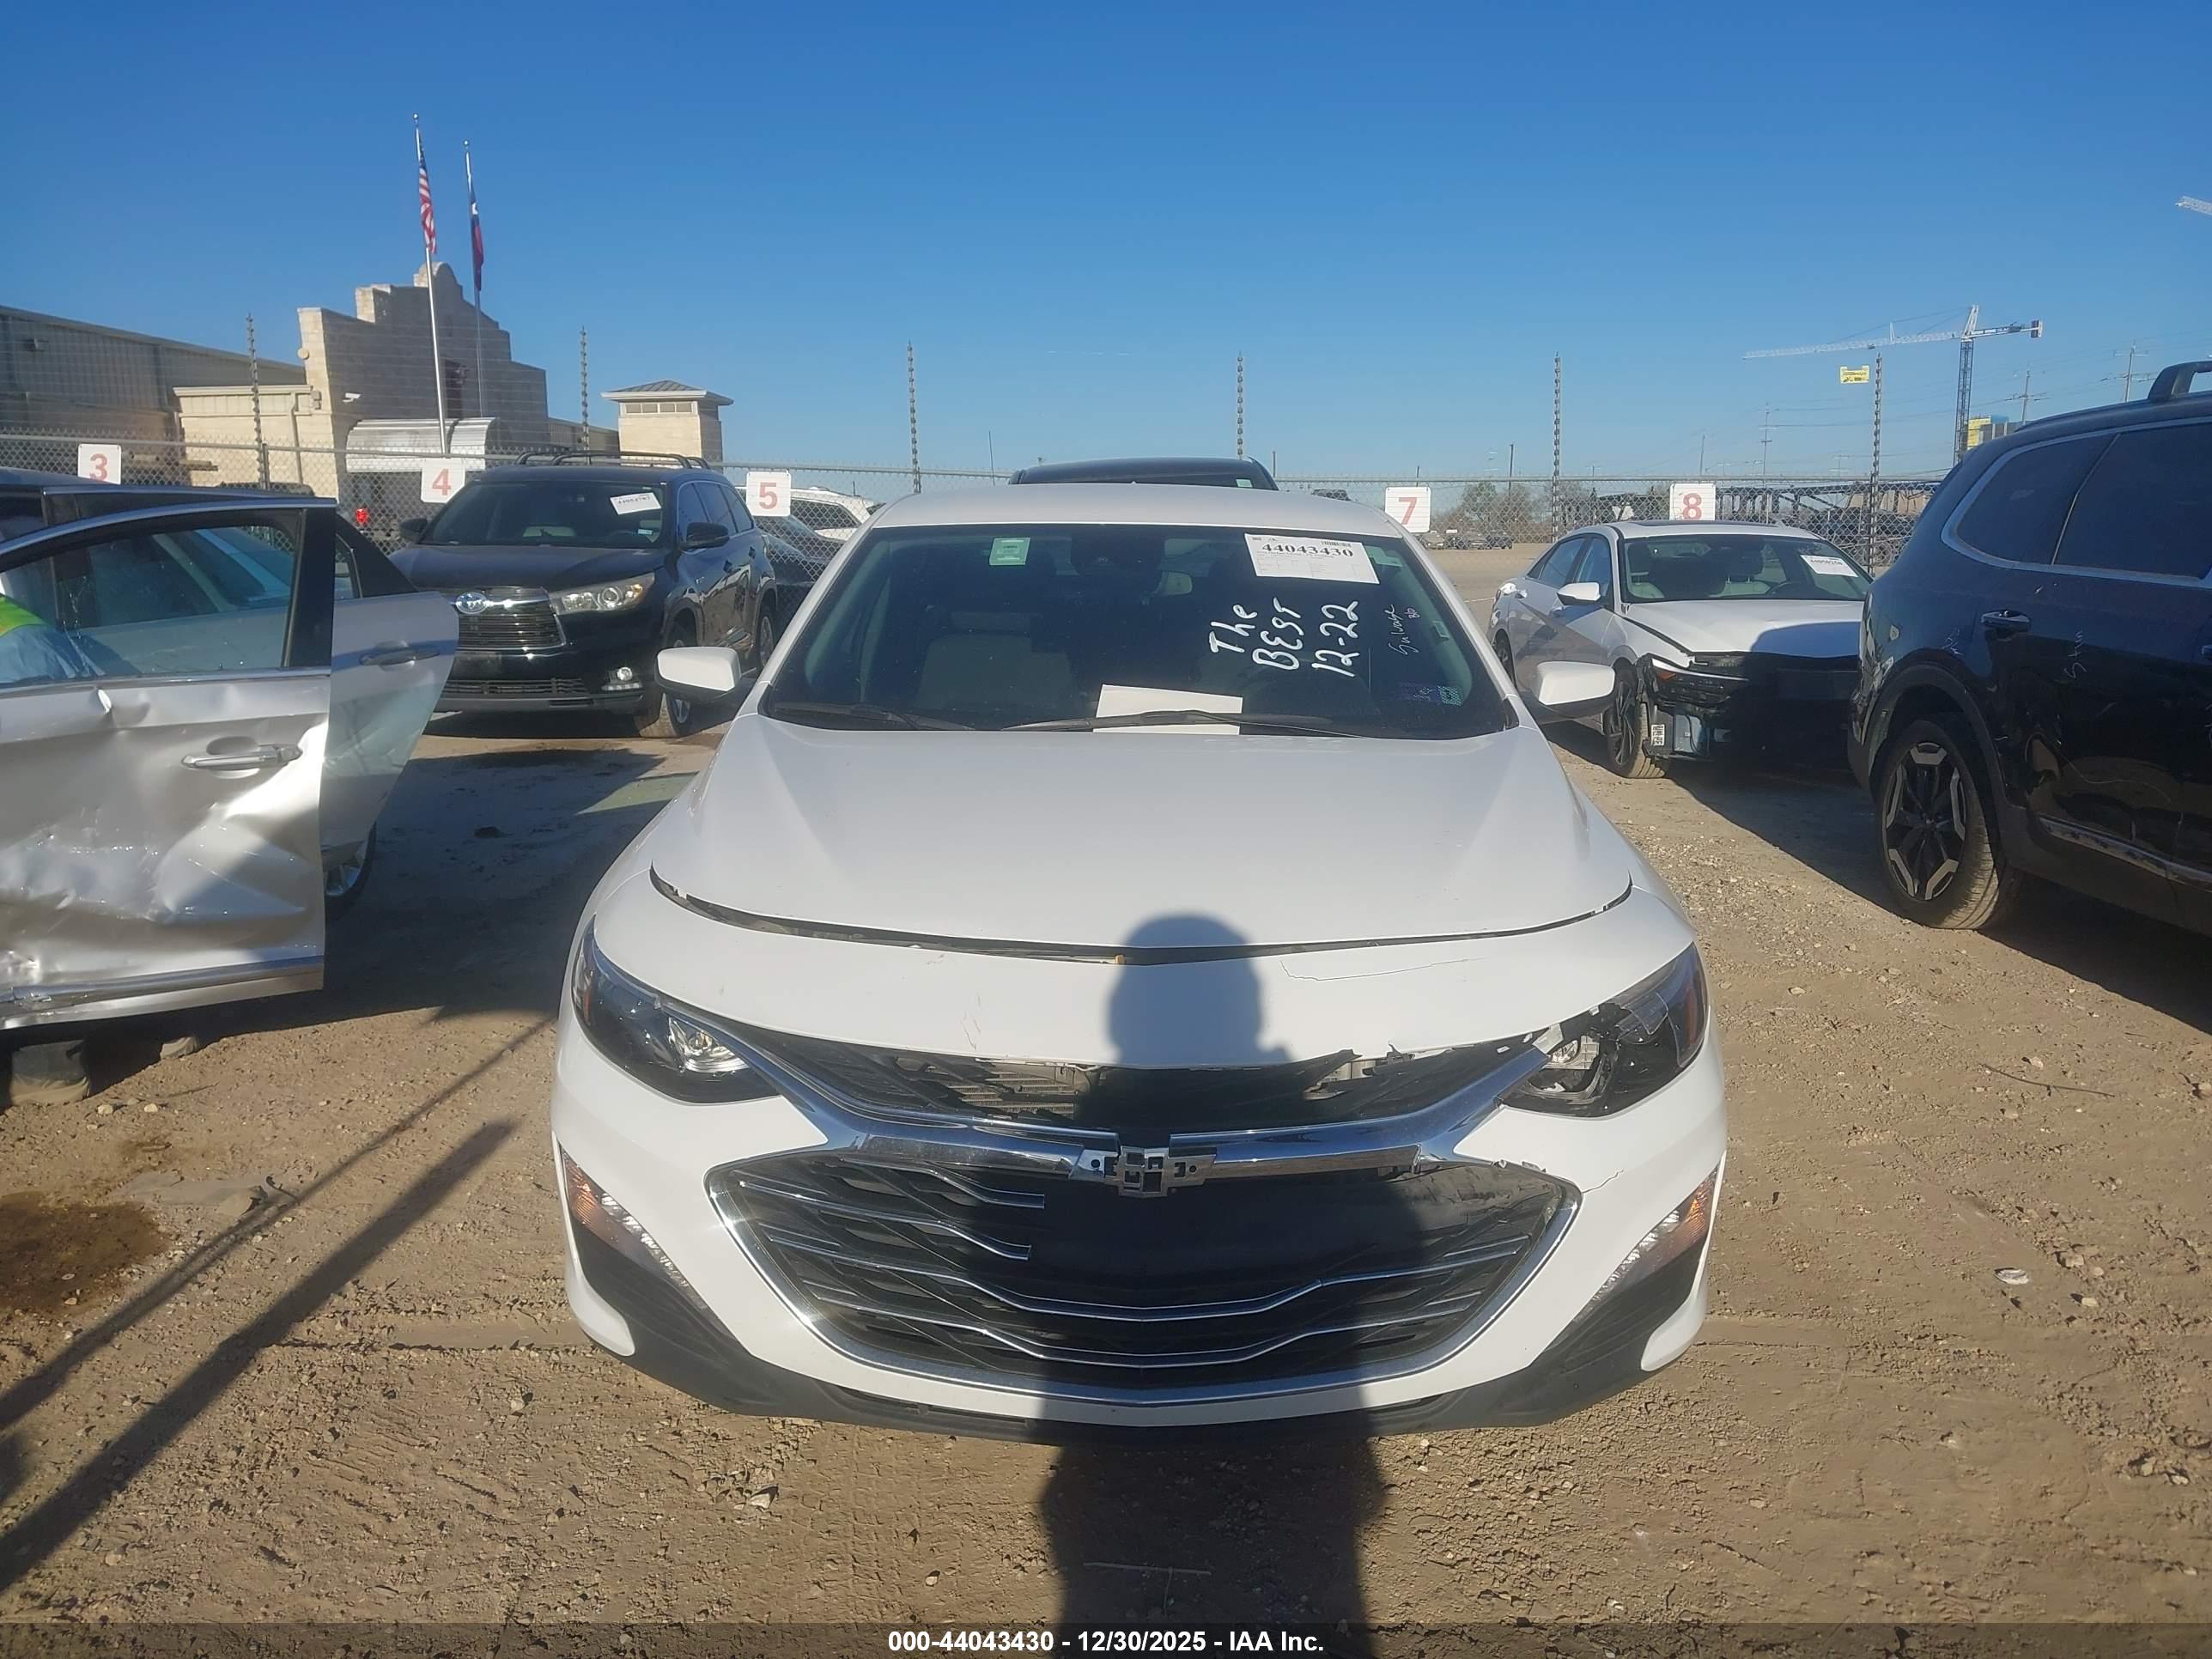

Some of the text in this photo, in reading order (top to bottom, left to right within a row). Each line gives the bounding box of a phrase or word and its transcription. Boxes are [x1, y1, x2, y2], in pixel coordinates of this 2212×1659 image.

[89, 453, 107, 481] 3
[431, 468, 452, 496] 4
[759, 482, 778, 510] 5
[1398, 497, 1418, 525] 7
[1683, 493, 1702, 520] 8
[1261, 544, 1354, 557] 44043430
[1208, 605, 1258, 653] The
[1311, 601, 1360, 677] 12-22
